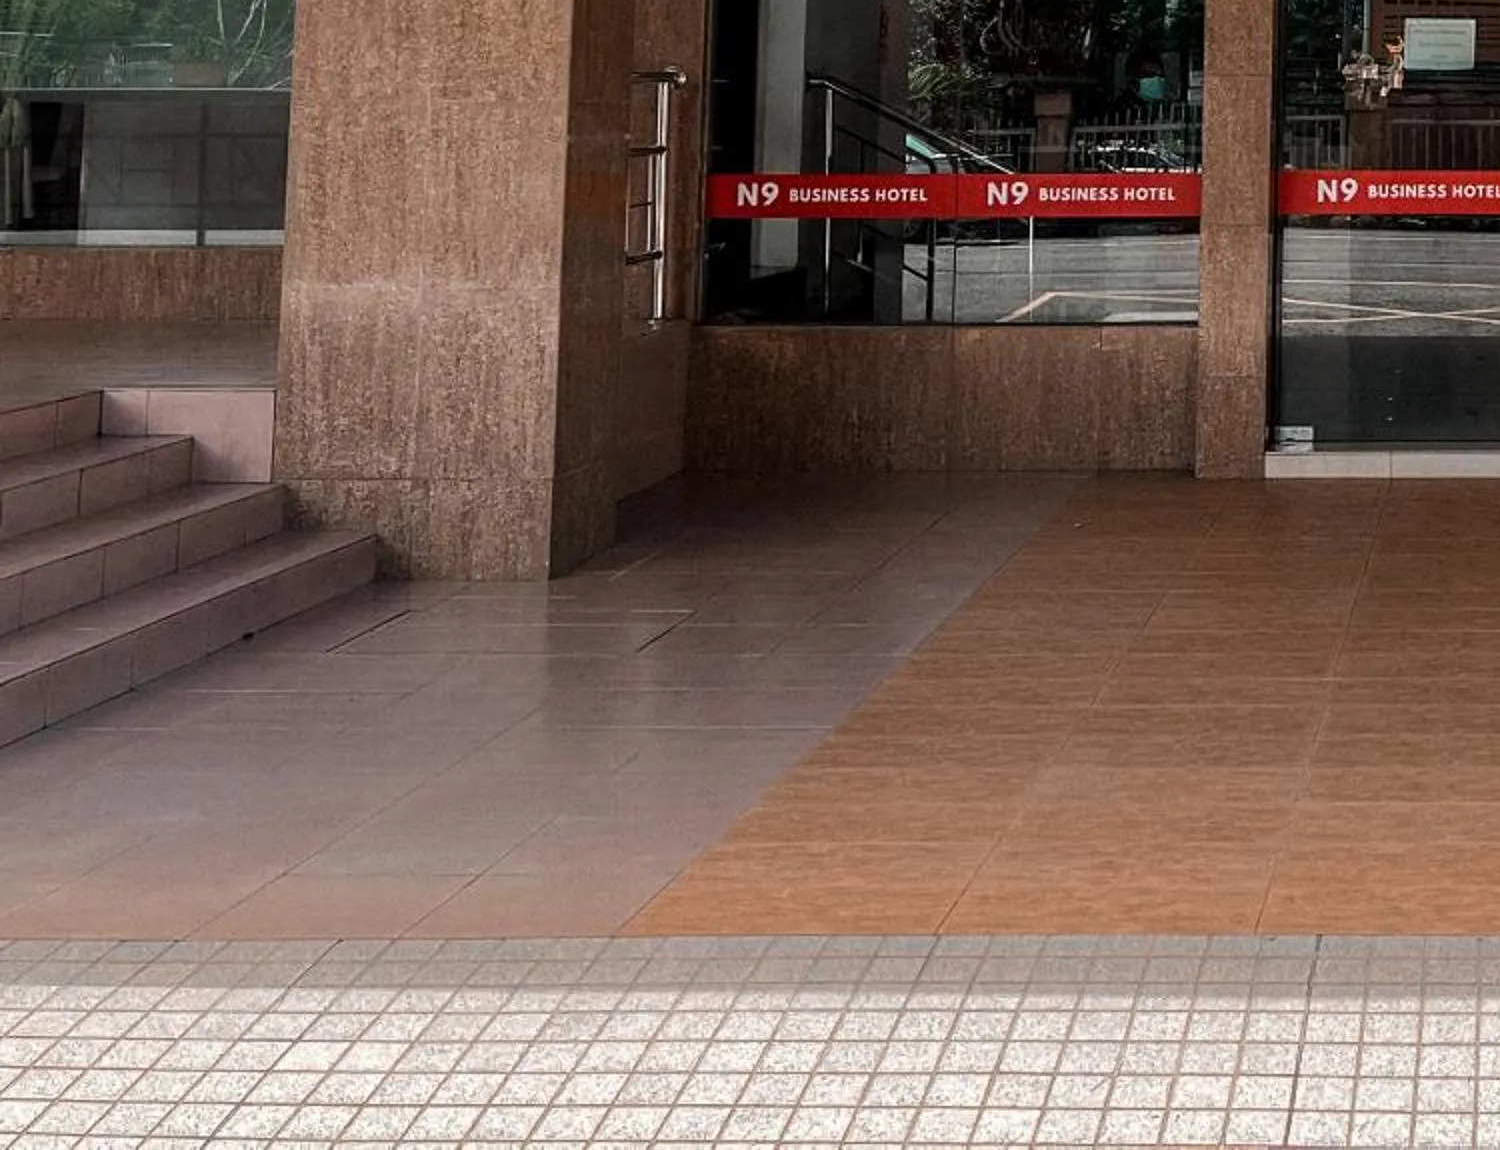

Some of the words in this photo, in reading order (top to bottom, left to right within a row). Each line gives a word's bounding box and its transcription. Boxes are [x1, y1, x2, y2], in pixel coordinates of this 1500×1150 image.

[737, 182, 779, 207] N9
[789, 187, 870, 202] BUSINESS
[875, 188, 928, 202] HOTEL
[987, 181, 1029, 206] N9
[1039, 187, 1119, 202] BUSINESS
[1123, 187, 1176, 201] HOTEL
[1317, 178, 1359, 203] N9
[1367, 183, 1447, 199] BUSINESS
